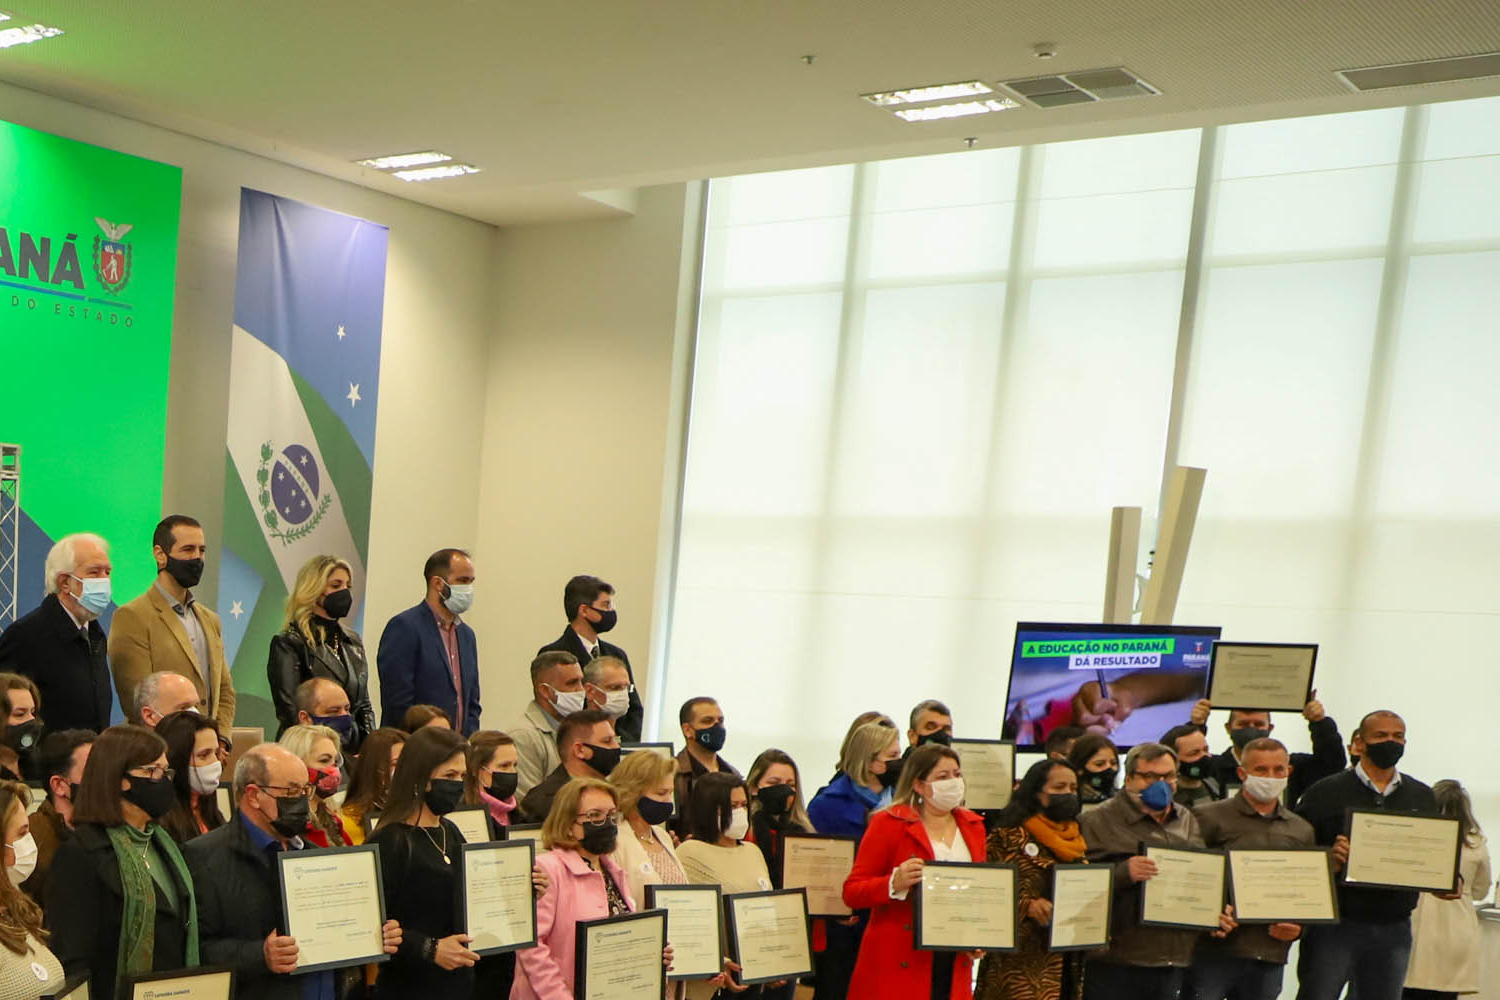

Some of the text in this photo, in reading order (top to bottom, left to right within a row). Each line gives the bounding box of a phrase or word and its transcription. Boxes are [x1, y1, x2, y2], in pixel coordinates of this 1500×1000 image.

[11, 295, 36, 310] DO
[55, 303, 133, 328] ESTADO
[1038, 640, 1100, 657] EDUCAÇÃO
[1103, 642, 1120, 652] NO
[1122, 639, 1168, 652] PARANÁ
[1075, 655, 1158, 666] DÁ RESULTADO
